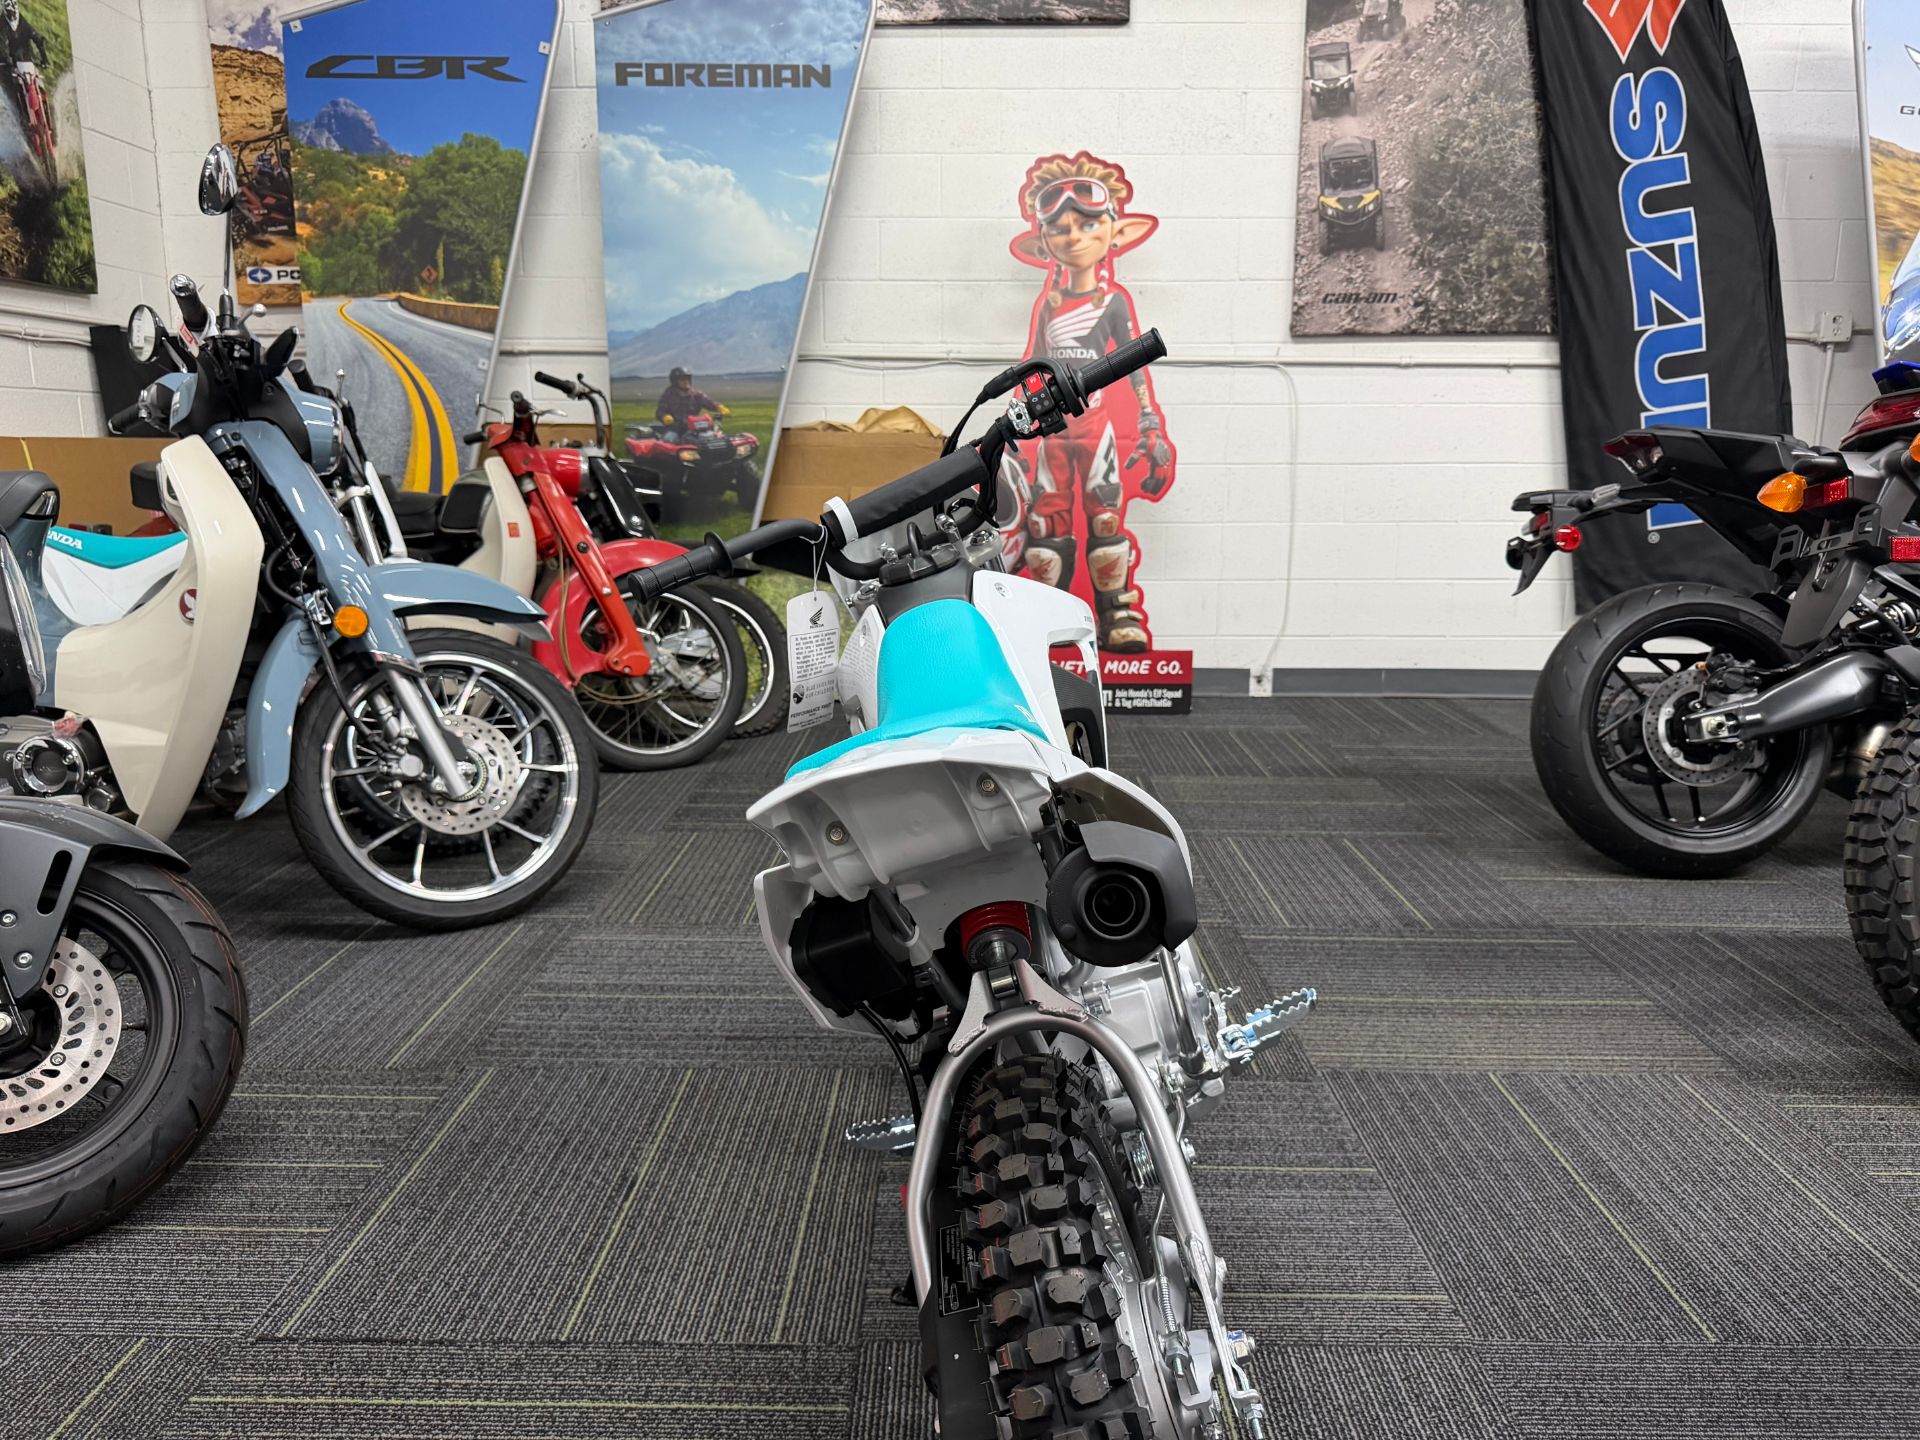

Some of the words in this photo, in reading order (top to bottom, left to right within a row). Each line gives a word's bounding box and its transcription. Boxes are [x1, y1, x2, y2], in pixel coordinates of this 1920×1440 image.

[305, 55, 528, 83] CBR
[615, 63, 831, 88] FOREMAN
[1609, 66, 1711, 530] SUZUI
[1048, 349, 1099, 359] HONDA
[47, 530, 83, 550] NDA
[1104, 660, 1152, 674] MORE
[1156, 660, 1183, 674] GO.
[1115, 689, 1127, 698] Join
[1162, 689, 1183, 699] Squad
